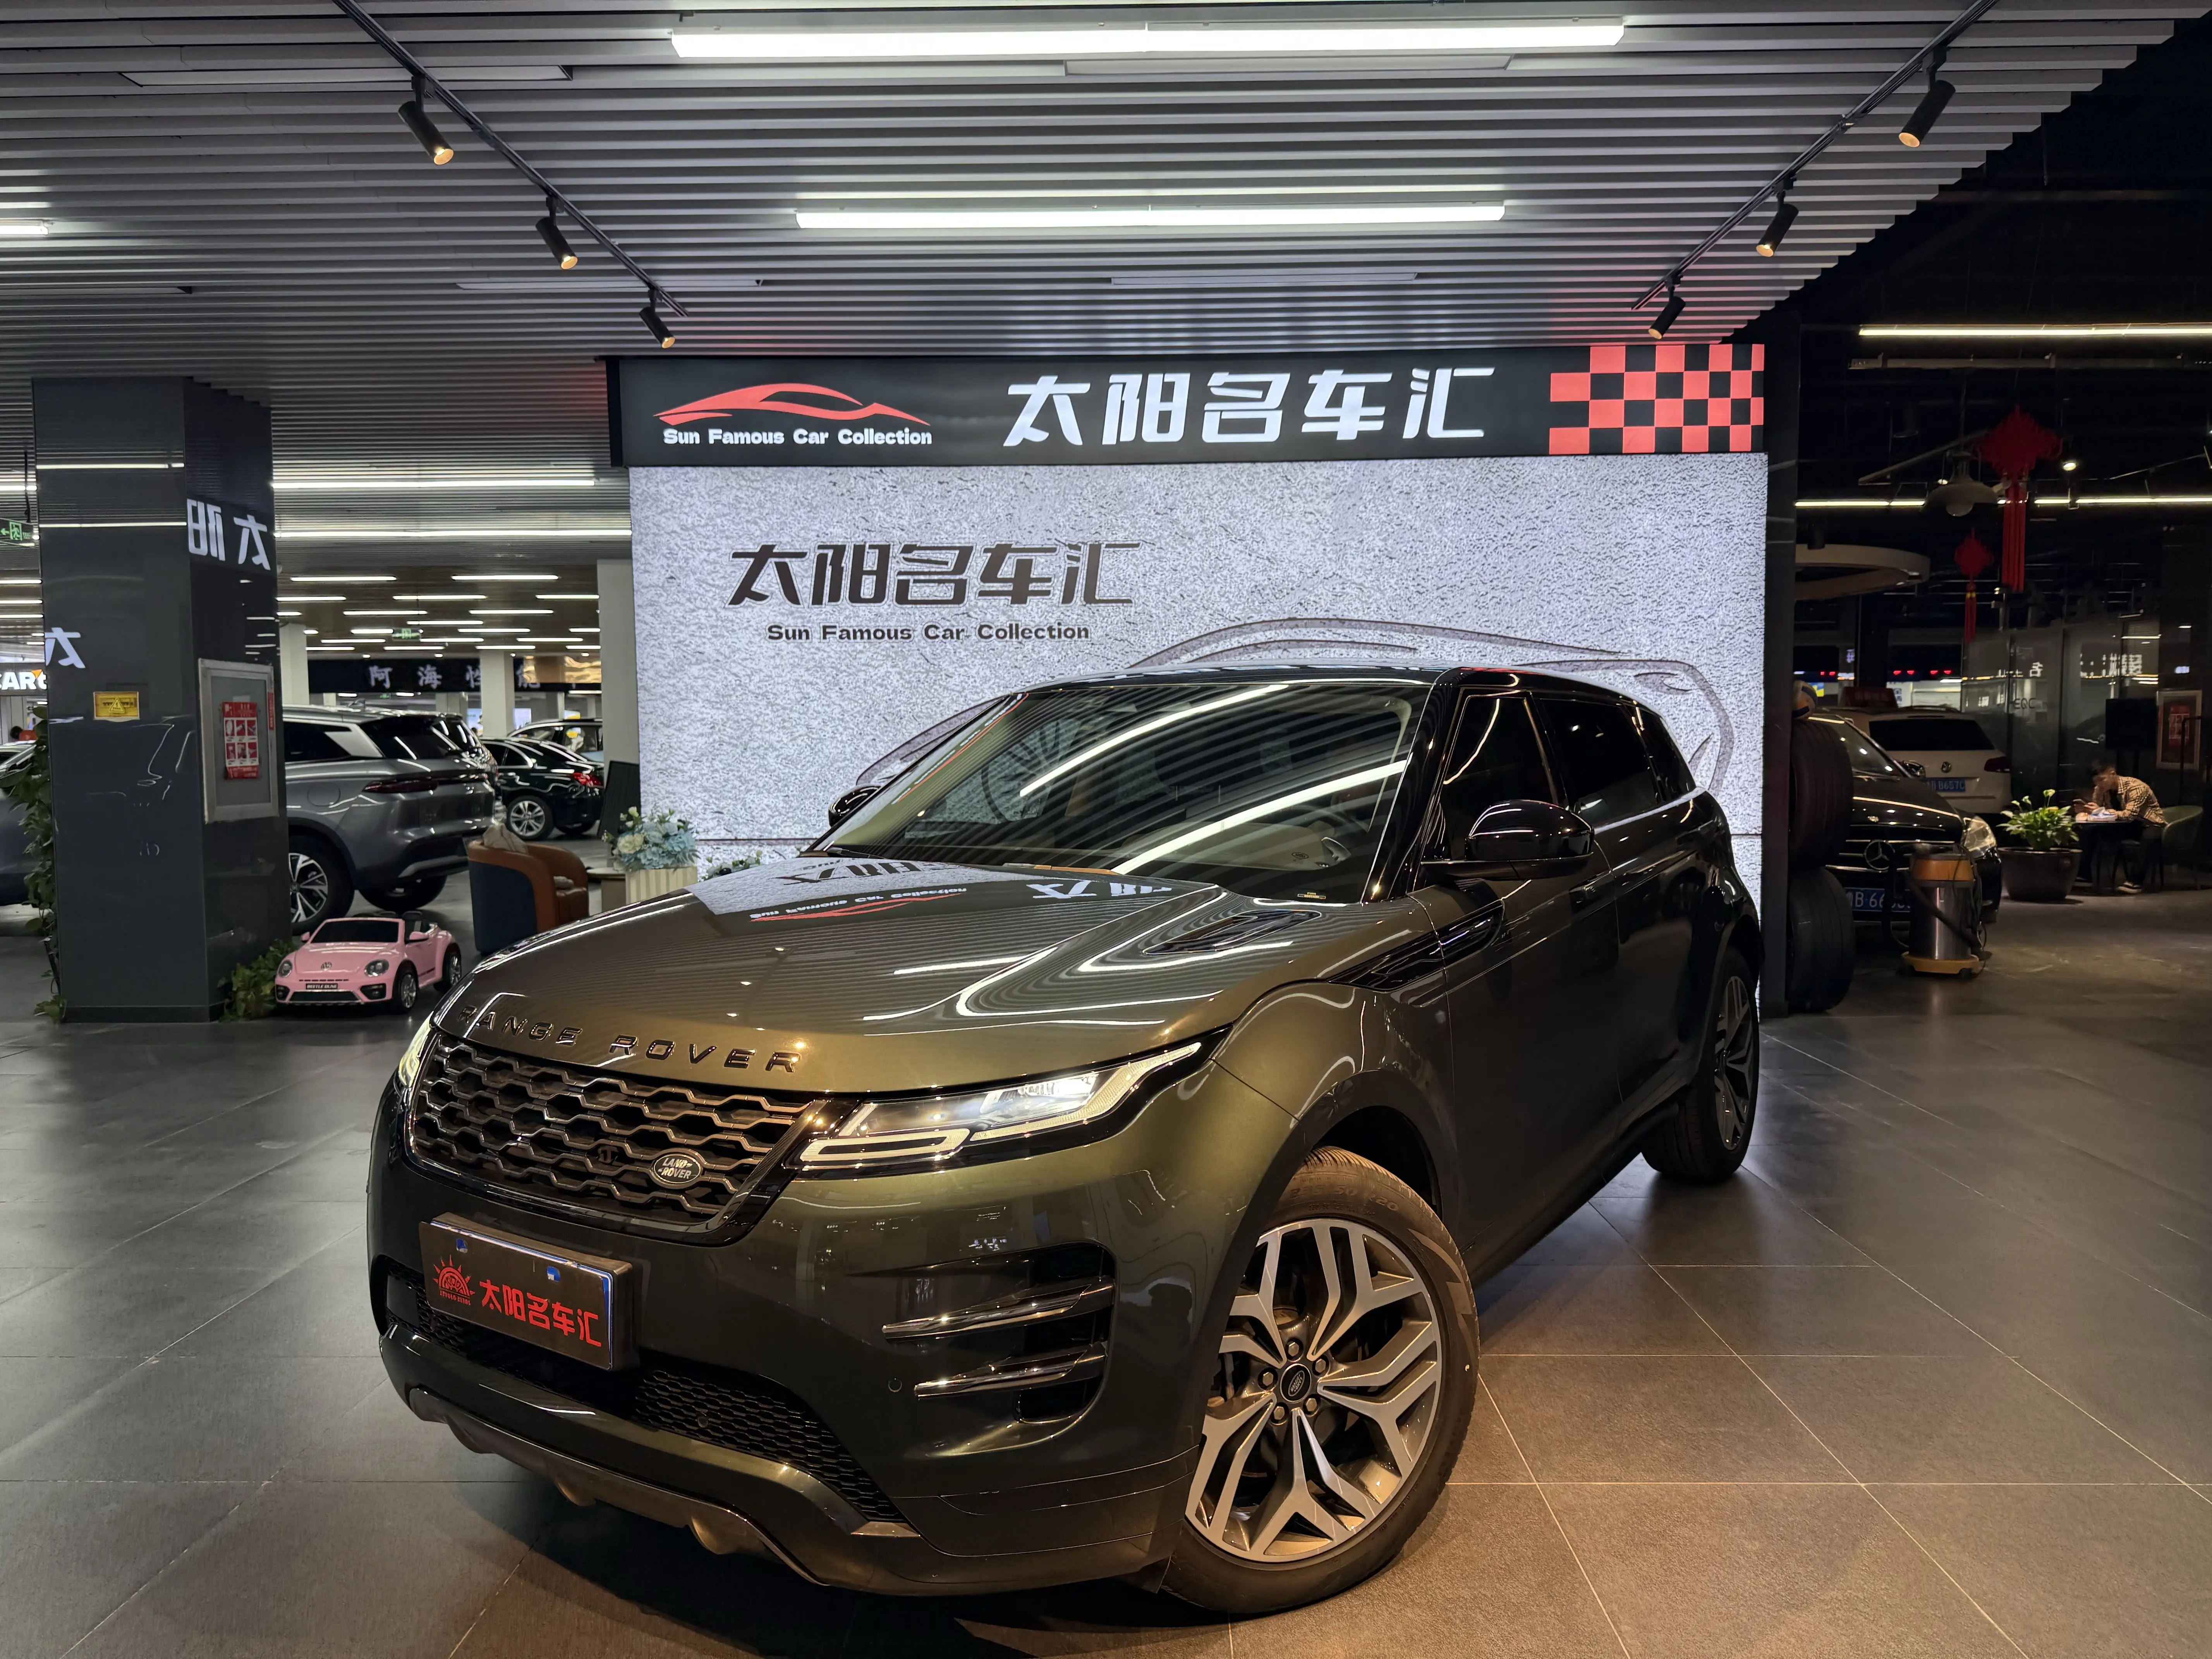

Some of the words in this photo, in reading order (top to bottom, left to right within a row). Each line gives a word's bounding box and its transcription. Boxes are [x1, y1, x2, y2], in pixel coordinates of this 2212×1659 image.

[1003, 368, 1495, 447] 太阳名车汇
[663, 428, 700, 445] Sun
[708, 429, 785, 445] Famous
[793, 428, 829, 445] Car
[837, 427, 933, 445] Collection
[728, 543, 1141, 606] 太阳名车汇
[768, 624, 810, 641] Sun
[822, 625, 912, 640] Famous
[924, 624, 965, 640] Car
[977, 622, 1089, 640] Collection
[457, 1006, 583, 1046] RANGE
[609, 1034, 802, 1073] ROVER
[661, 1167, 692, 1179] ROVER
[662, 1158, 689, 1168] LAND
[479, 1279, 602, 1347] 太阳名车汇
